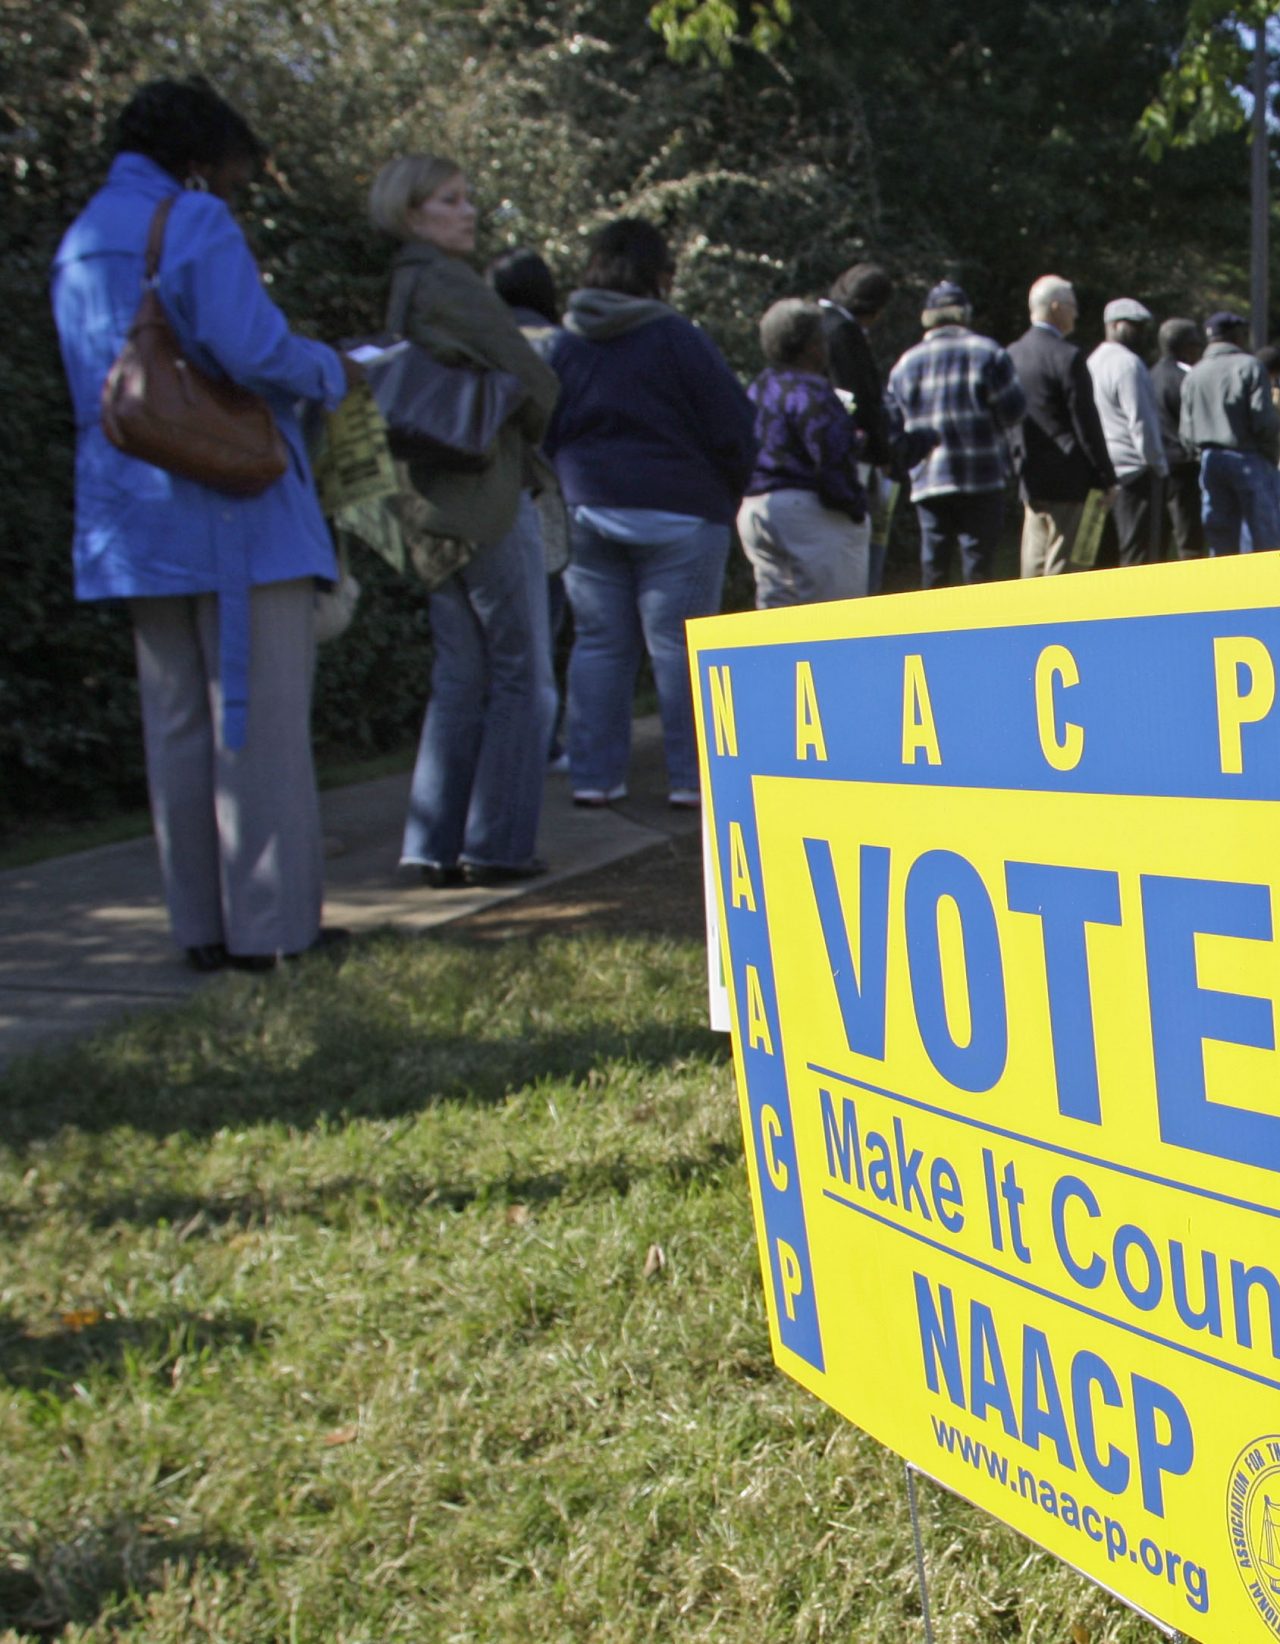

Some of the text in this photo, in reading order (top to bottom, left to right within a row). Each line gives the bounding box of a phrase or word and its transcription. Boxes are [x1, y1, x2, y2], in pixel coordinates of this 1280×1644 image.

[819, 1088, 965, 1233] Make
[982, 1148, 1032, 1264] It
[913, 1270, 1195, 1518] NAACP
[931, 1414, 1210, 1614] www.naacp.org
[1230, 1469, 1253, 1569] ASSOCIATION
[1244, 1448, 1266, 1475] FOR
